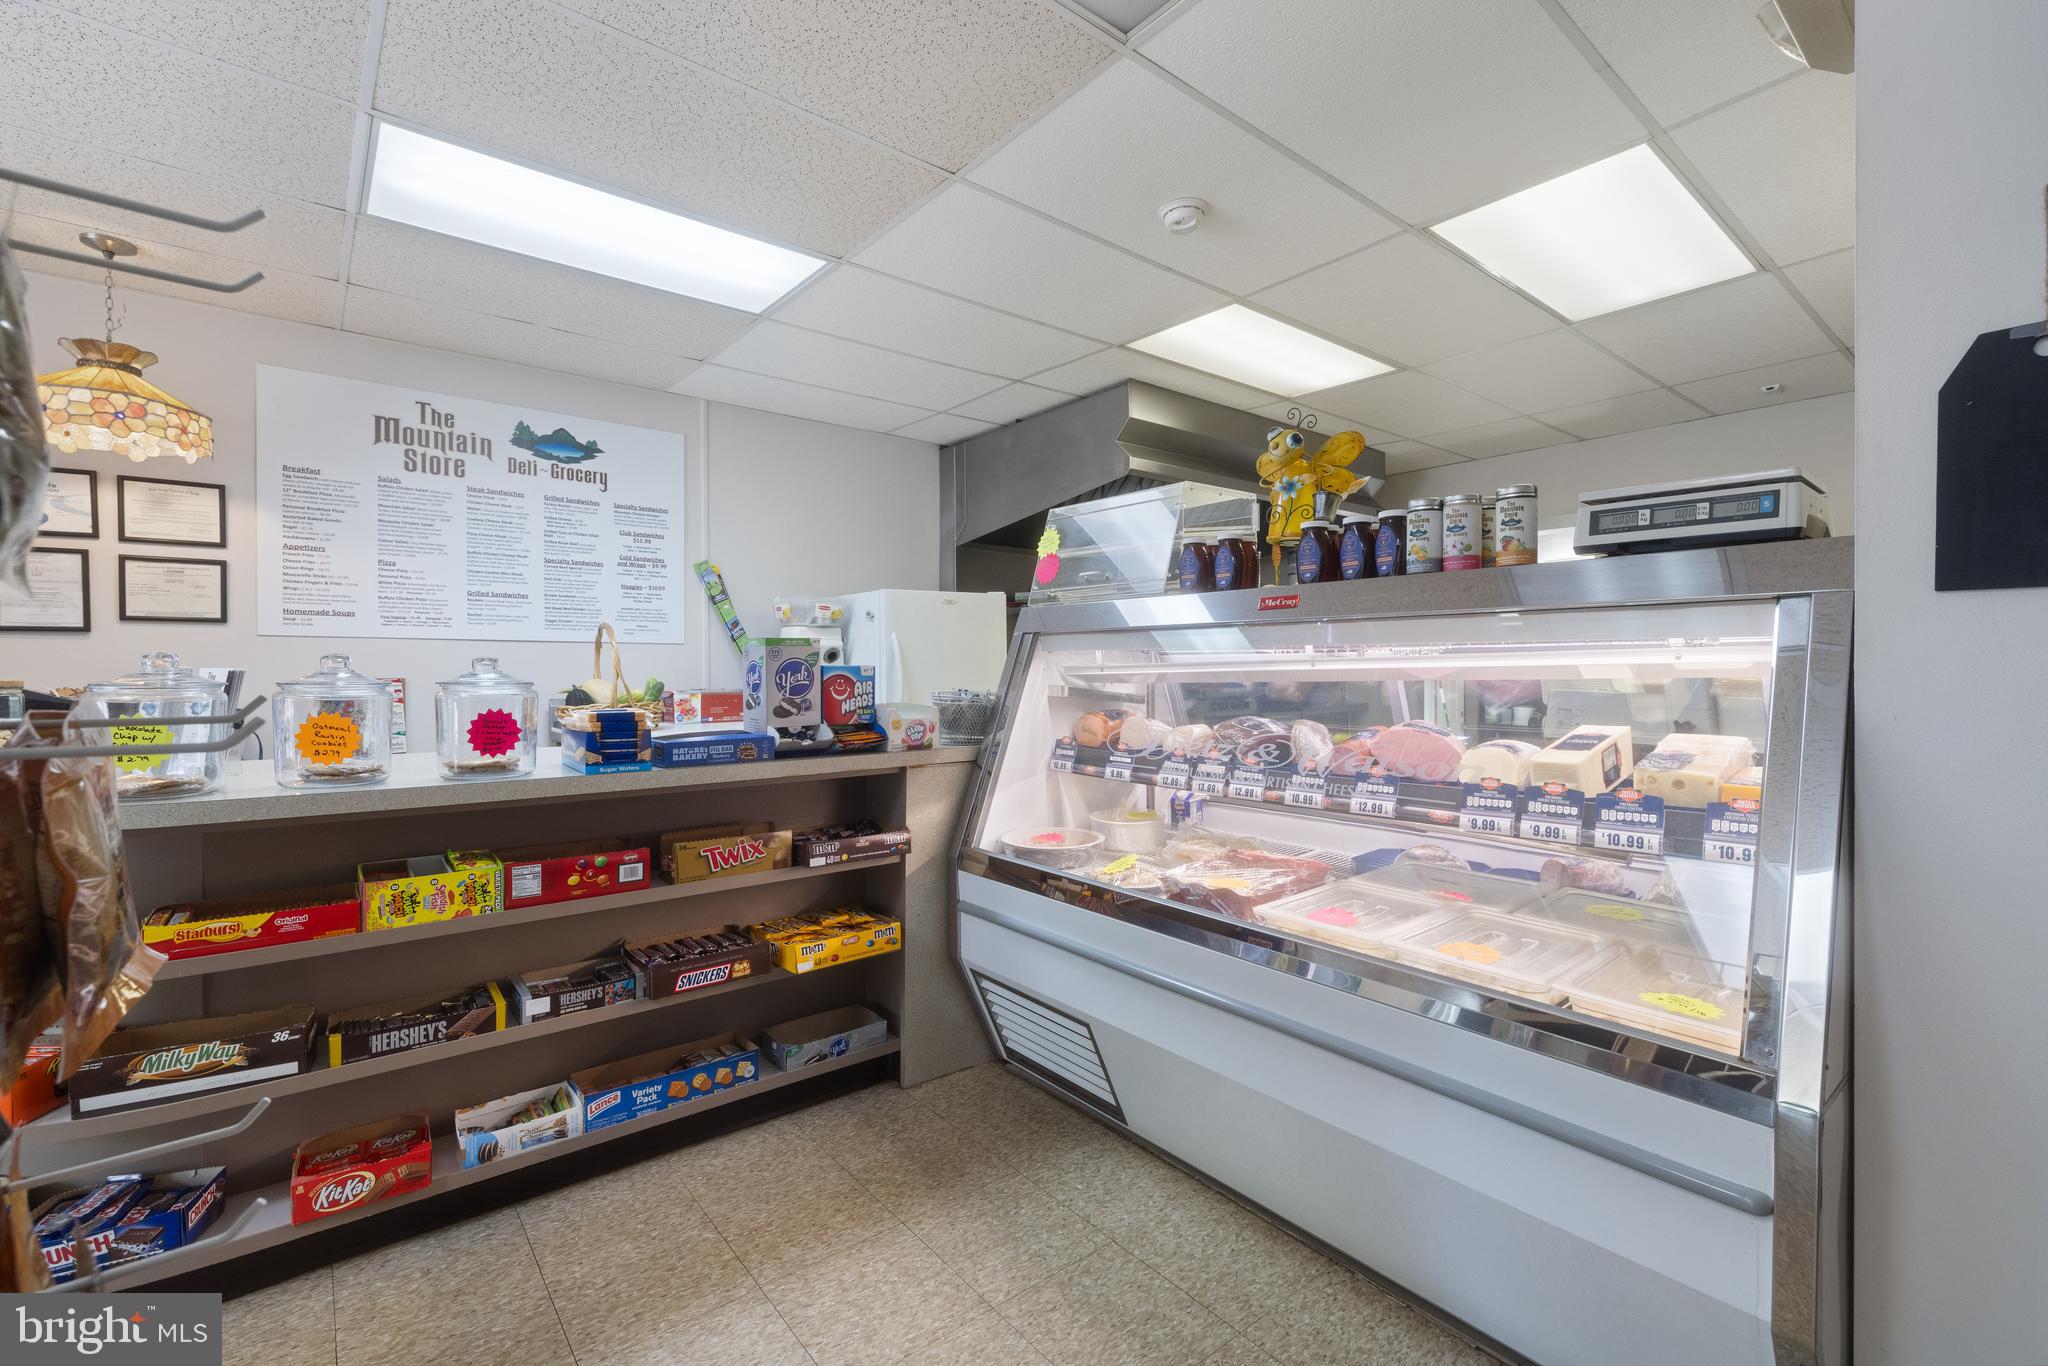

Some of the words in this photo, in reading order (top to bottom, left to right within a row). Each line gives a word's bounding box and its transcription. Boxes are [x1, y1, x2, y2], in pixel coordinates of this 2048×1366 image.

[415, 401, 455, 429] The
[373, 414, 493, 462] Mountain
[404, 448, 466, 478] Store
[282, 464, 321, 475] Breakfast
[508, 457, 537, 477] Deli
[551, 463, 608, 492] Grocery
[377, 475, 401, 485] Salads
[466, 485, 486, 494] Steak
[487, 488, 525, 498] Sandwiches
[544, 495, 565, 503] Grilled
[565, 497, 600, 507] Sandwiches
[613, 502, 638, 511] Specialty
[638, 505, 669, 514] Sandwiches
[633, 531, 665, 540] Sandwiches
[282, 543, 326, 552] Appetizers
[378, 559, 396, 567] Pizza
[544, 557, 570, 566] Specialty
[570, 559, 604, 568] Sandwiches
[633, 555, 665, 564] Sandwiches
[467, 590, 490, 598] Grilled
[491, 592, 529, 600] Sandwiches
[1265, 597, 1297, 607] McCray
[282, 608, 330, 617] Homemade
[332, 609, 356, 617] Soups
[776, 670, 813, 697] York
[854, 680, 874, 697] AIR
[841, 695, 874, 715] HEADS
[117, 724, 163, 734] Chocolate
[312, 722, 351, 733] Oatmeal
[906, 725, 926, 737] BLOW
[113, 732, 139, 744] Chip
[314, 731, 346, 741] Raisin
[909, 732, 925, 741] POP
[311, 740, 348, 748] Cookies
[672, 753, 709, 762] BAKERY
[701, 838, 766, 873] Twix
[826, 854, 834, 864] 48
[1718, 844, 1758, 862] 10.9
[430, 893, 438, 910] Fish
[437, 884, 448, 914] Swedish
[275, 915, 309, 925] Original
[175, 922, 241, 942] Starburst
[842, 936, 858, 945] PEANUT
[678, 965, 730, 990] SNICKERS
[560, 986, 604, 1006] HERSHEY'S
[271, 1030, 290, 1043] 36
[371, 1020, 448, 1054] HERSHEY'S
[631, 1084, 663, 1099] Variety
[589, 1093, 620, 1115] Lance
[636, 1094, 658, 1105] Pack
